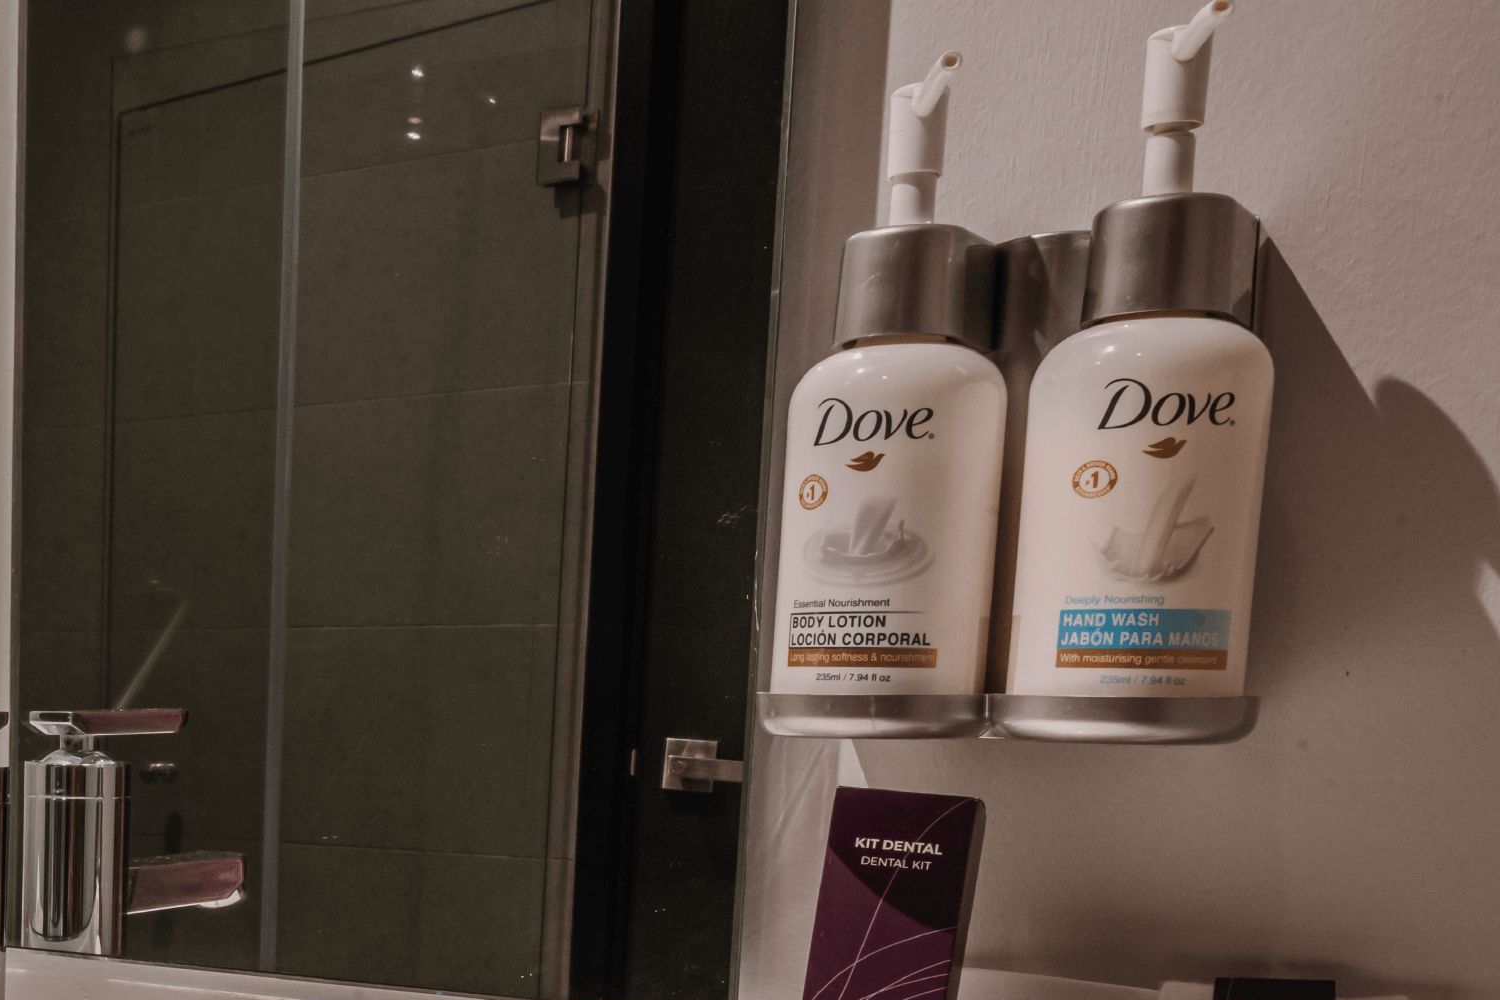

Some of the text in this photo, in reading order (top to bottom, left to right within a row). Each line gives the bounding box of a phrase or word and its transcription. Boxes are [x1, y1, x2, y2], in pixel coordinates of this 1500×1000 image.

[1097, 378, 1235, 430] Dove
[813, 398, 934, 446] Dove
[794, 598, 890, 609] Essential Nourishment
[1104, 595, 1165, 607] Nourishing
[792, 615, 887, 628] BODY LOTION
[1063, 613, 1159, 627] HAND WASH
[791, 630, 931, 646] LOCIÓN CORPORAL
[1060, 628, 1220, 647] JABÓN PARA MANOS
[831, 653, 869, 663] softness
[1060, 653, 1081, 663] With
[1082, 653, 1142, 666] moisturising
[816, 673, 841, 682] 235ml
[849, 673, 869, 682] 7.94
[855, 837, 943, 856] KIT DENTAL
[860, 856, 932, 871] DENTAL KIT
